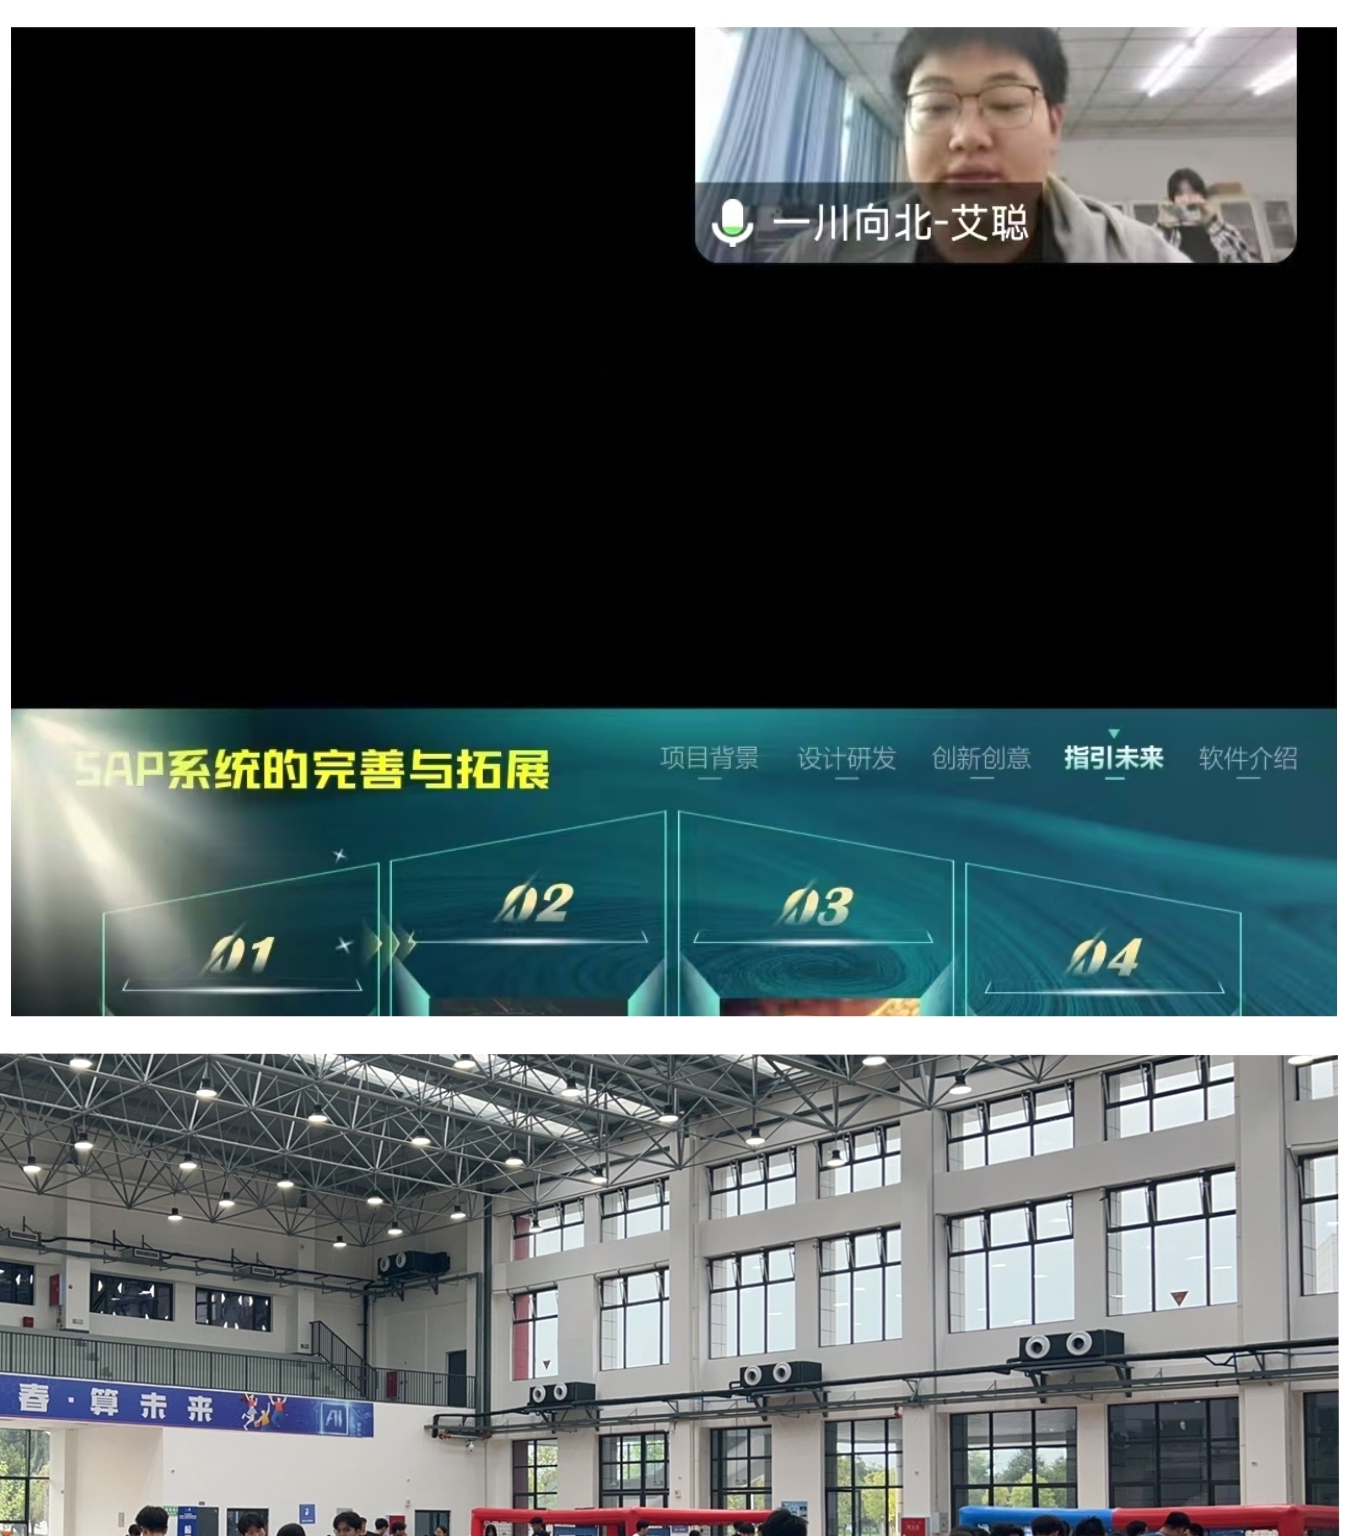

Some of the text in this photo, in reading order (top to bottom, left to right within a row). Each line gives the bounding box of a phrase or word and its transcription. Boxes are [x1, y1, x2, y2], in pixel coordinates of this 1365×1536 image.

[773, 202, 1030, 242] 一川向北-艾聪
[75, 749, 550, 790] SAP系统的完善与拓展
[660, 745, 759, 771] 项目背景
[798, 745, 897, 771] 设计研发
[932, 745, 1032, 771] 创新创意
[1064, 745, 1164, 771] 指引未来
[1199, 745, 1298, 771] 软件介绍
[495, 881, 574, 923] 02
[777, 882, 854, 927] 03
[201, 930, 275, 975] 01
[1067, 933, 1144, 978] 04
[324, 1404, 346, 1428] AI
